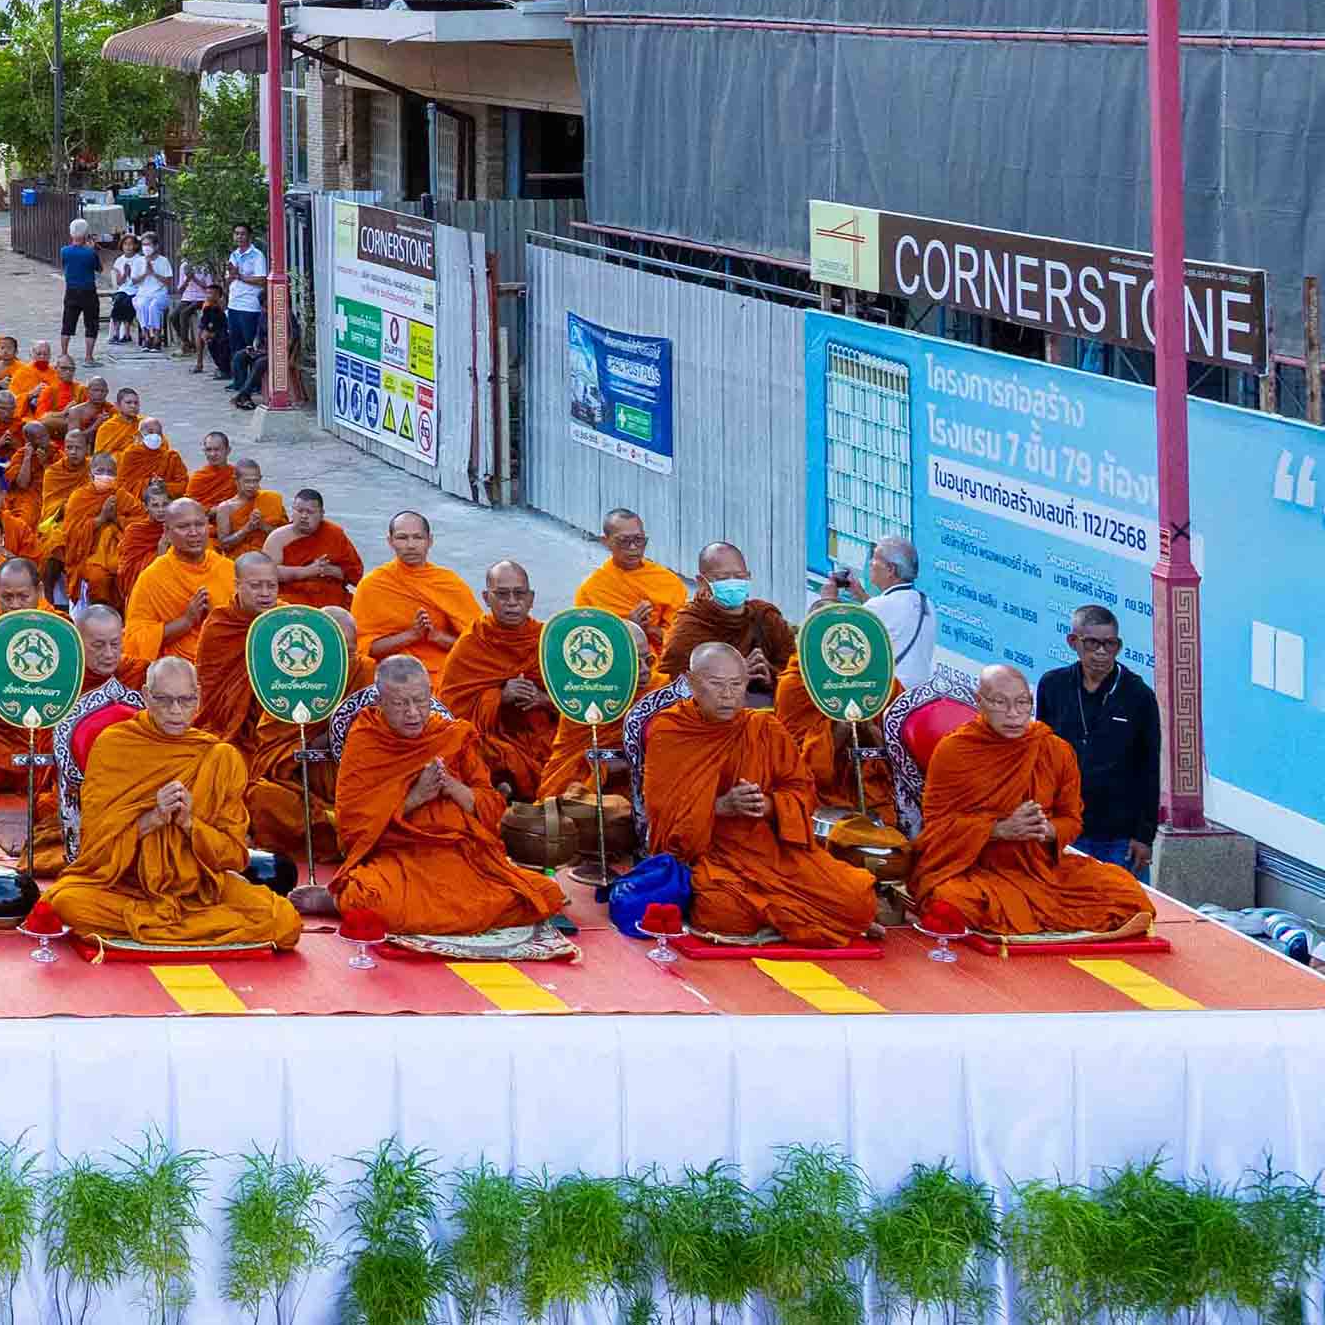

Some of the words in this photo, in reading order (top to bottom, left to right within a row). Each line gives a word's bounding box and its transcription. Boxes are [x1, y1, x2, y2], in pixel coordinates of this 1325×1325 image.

[361, 226, 433, 270] CORNERSTONE
[925, 353, 1084, 428] โครงการก่อสร้าง
[926, 403, 1002, 461] โรงแรม
[1006, 431, 1019, 466] 7
[1025, 420, 1057, 480] ชั้น
[1060, 446, 1093, 487] 79
[1082, 511, 1147, 551] 112/2568
